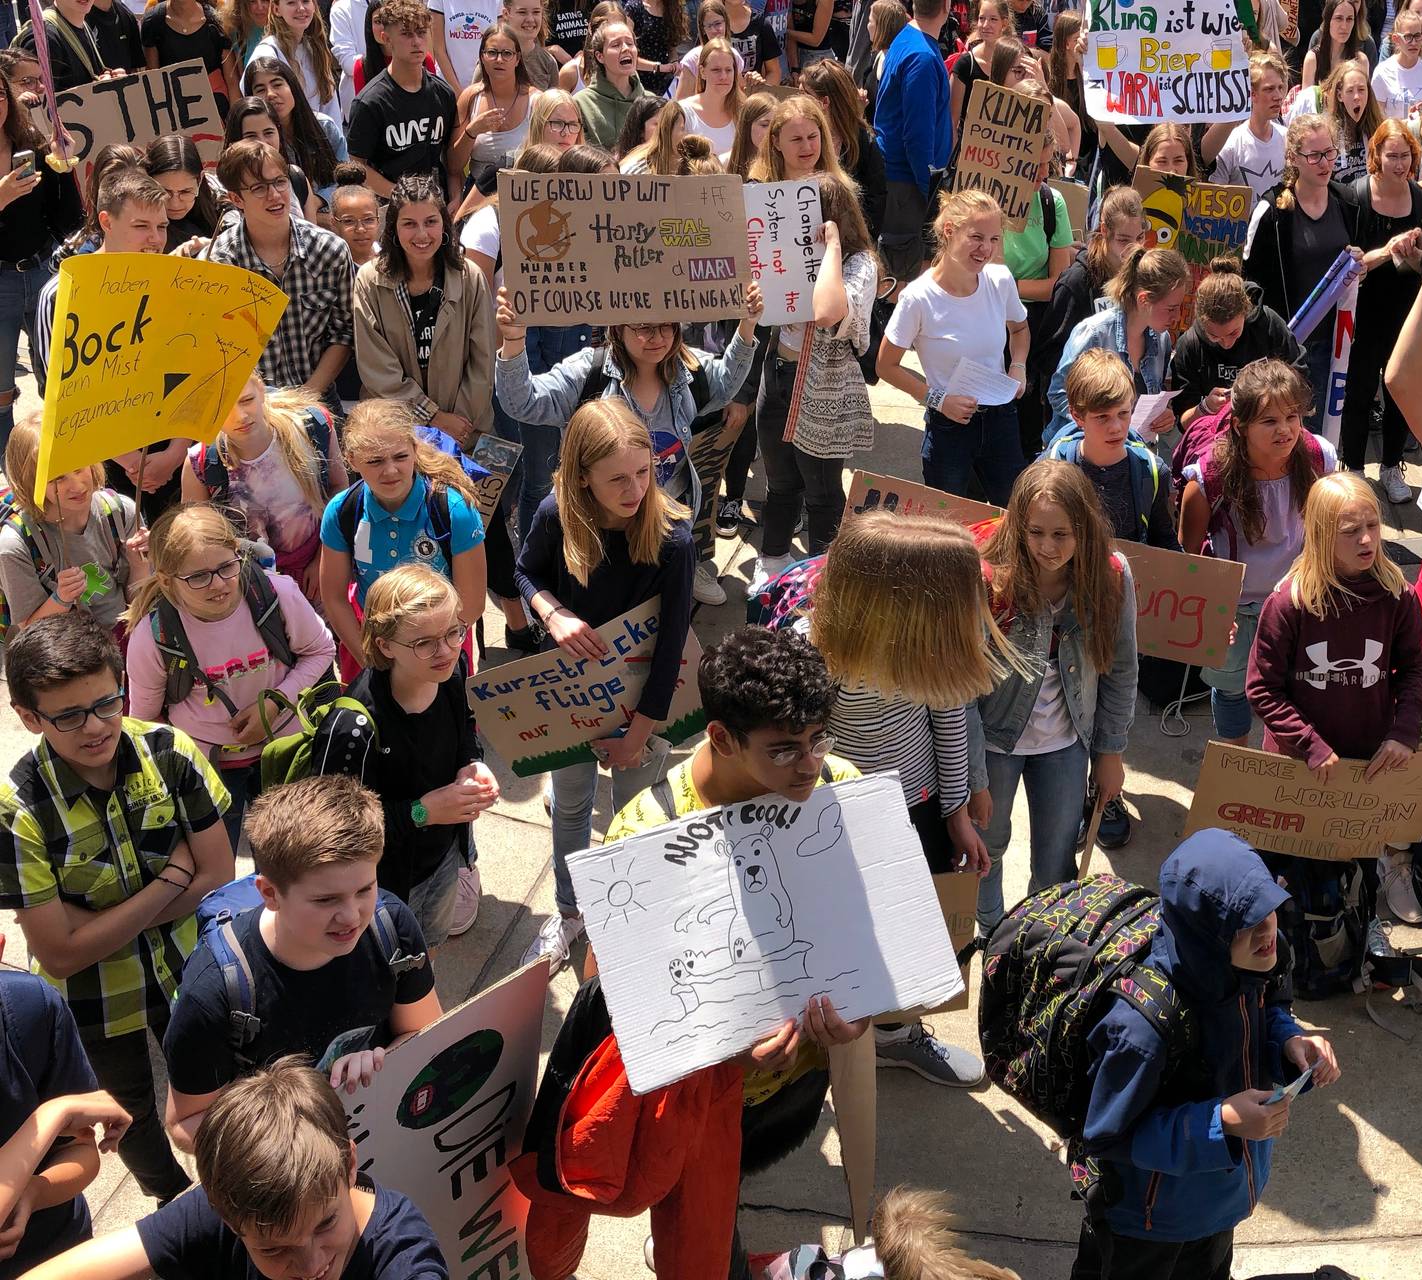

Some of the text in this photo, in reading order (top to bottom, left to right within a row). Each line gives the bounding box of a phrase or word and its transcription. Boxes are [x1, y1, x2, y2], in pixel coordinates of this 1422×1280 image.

[556, 11, 583, 21] EATING
[556, 19, 589, 31] ANIMALS
[1165, 1, 1195, 33] ist
[1202, 3, 1241, 36] wie
[565, 28, 588, 38] WEIRD
[1139, 37, 1201, 74] Bier
[93, 65, 209, 143] THE
[1106, 68, 1252, 117] WARM ist SCHEISSE
[979, 87, 1044, 134] KLIMA
[970, 123, 1033, 155] POLITIK
[964, 145, 1039, 183] MUSS SICH
[511, 179, 540, 201] WE
[547, 178, 593, 201] GREW
[603, 180, 631, 201] UP
[589, 214, 658, 244] Harry
[794, 185, 823, 283] Change the
[614, 245, 664, 274] Potter
[747, 217, 768, 280] Climate
[765, 188, 800, 313] System not the
[100, 265, 150, 296] haben
[170, 265, 230, 296] keinen
[530, 275, 588, 284] GAMES
[610, 290, 651, 310] WE'RE
[61, 295, 152, 381] Bock
[102, 352, 141, 382] Mist
[535, 676, 626, 713] flüge
[519, 723, 550, 742] nur
[571, 712, 604, 731] für
[1221, 752, 1297, 780] MAKE
[1275, 785, 1380, 811] WORLD
[1217, 801, 1306, 833] GRETA
[664, 803, 802, 867] NOT COOL!
[433, 1080, 518, 1201] DIE
